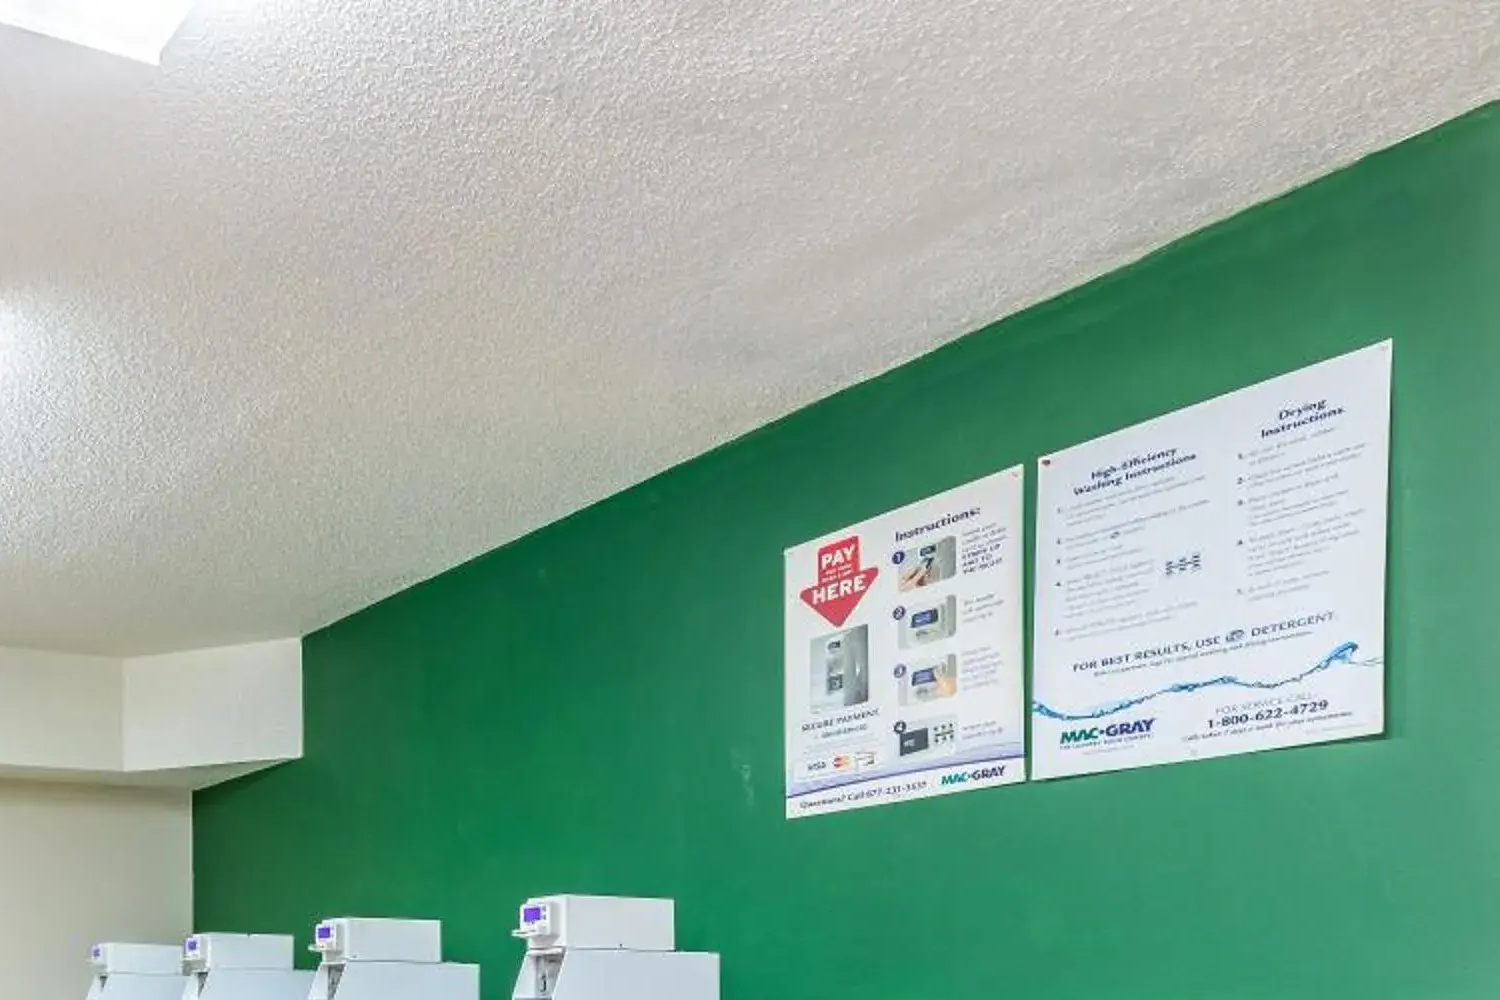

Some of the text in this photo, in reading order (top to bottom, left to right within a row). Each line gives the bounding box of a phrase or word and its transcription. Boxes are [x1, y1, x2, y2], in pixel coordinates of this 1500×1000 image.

[1261, 408, 1344, 439] Instructions
[1279, 400, 1327, 420] Drying
[1073, 454, 1197, 496] Washing Instructions
[1091, 448, 1177, 480] High-Efficiency
[895, 507, 981, 542] Instructions:
[821, 545, 856, 570] PAY
[811, 574, 868, 605] HERE
[1073, 659, 1098, 672] FOR
[1101, 653, 1131, 667] BEST
[1195, 635, 1220, 649] USE
[1207, 699, 1329, 729] 1-800-622-4729
